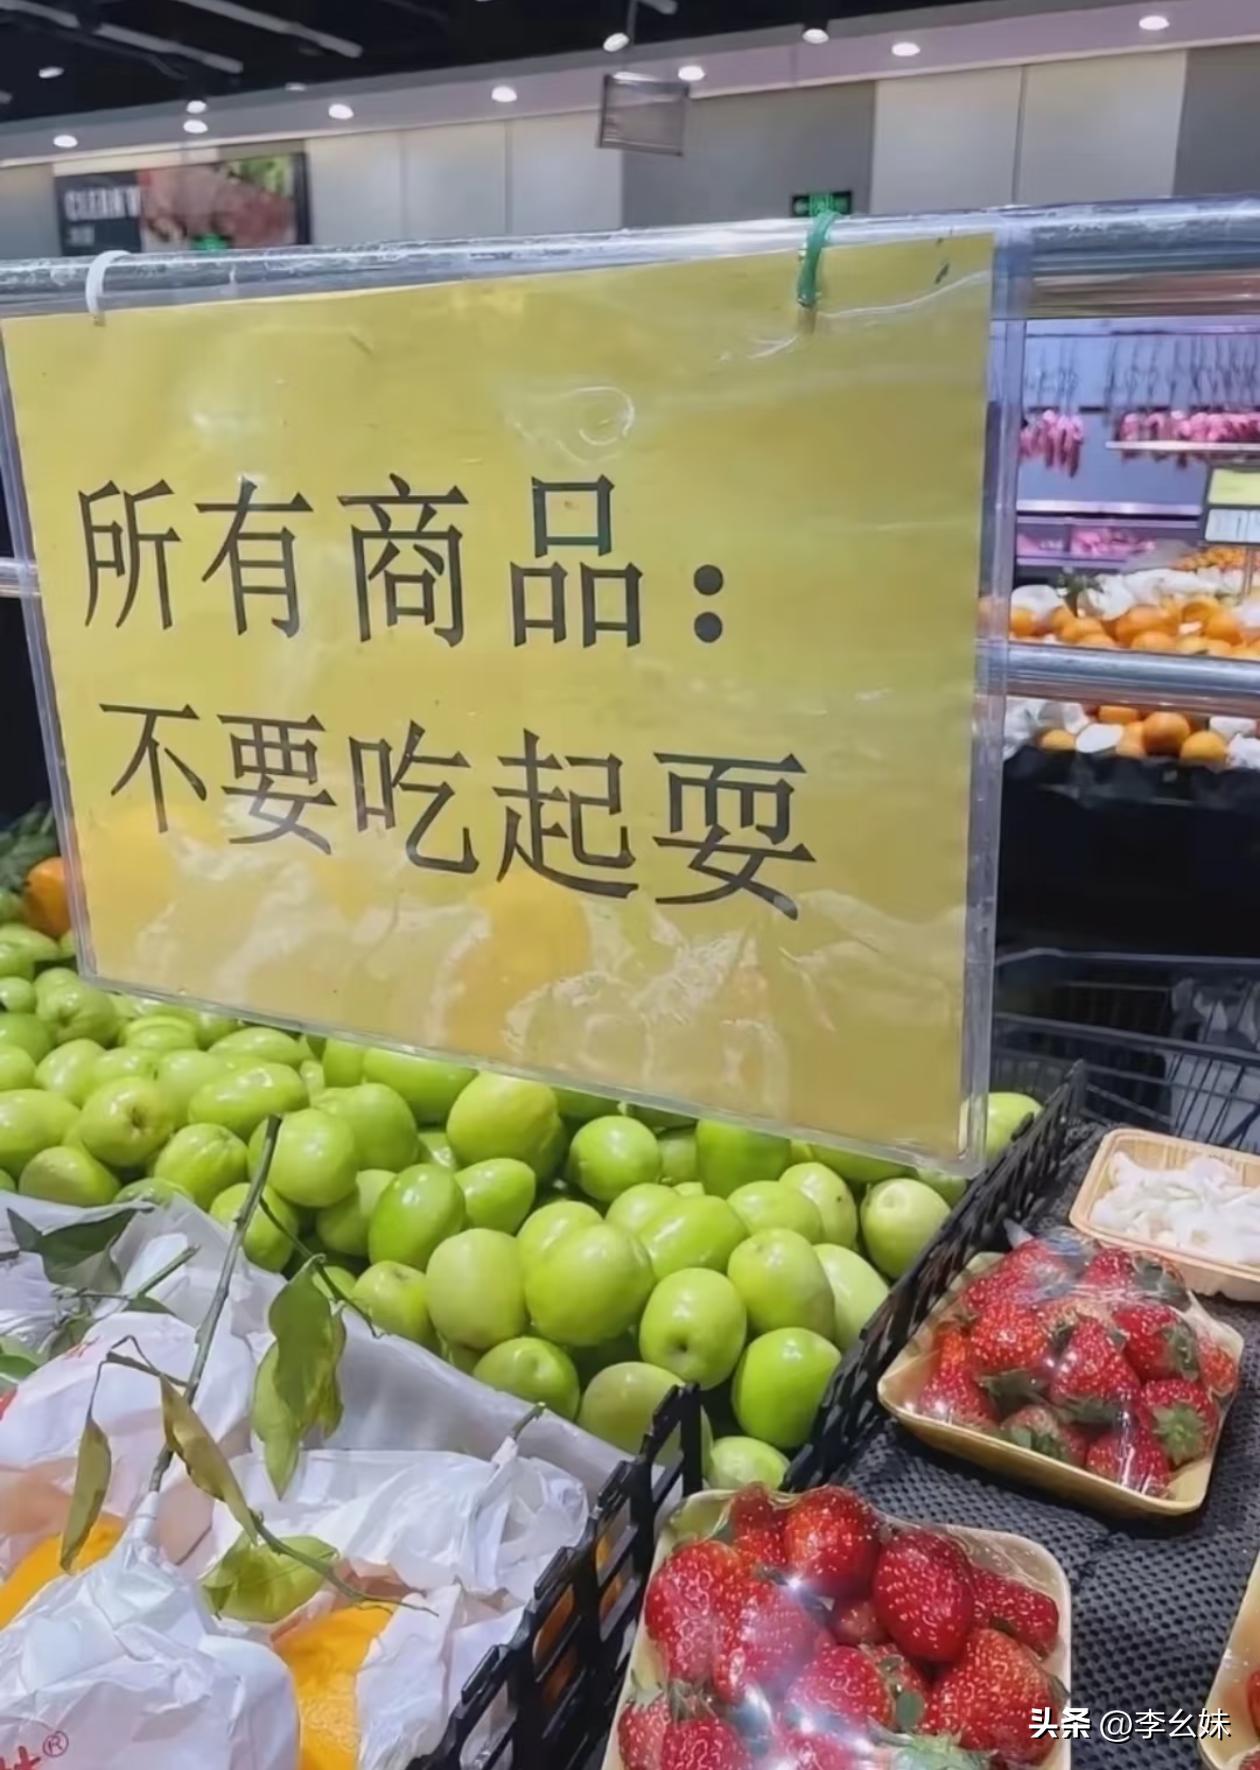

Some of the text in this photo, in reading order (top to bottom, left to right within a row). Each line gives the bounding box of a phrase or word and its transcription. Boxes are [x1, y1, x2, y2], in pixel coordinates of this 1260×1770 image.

[99, 703, 816, 921] 不要吃起耍
